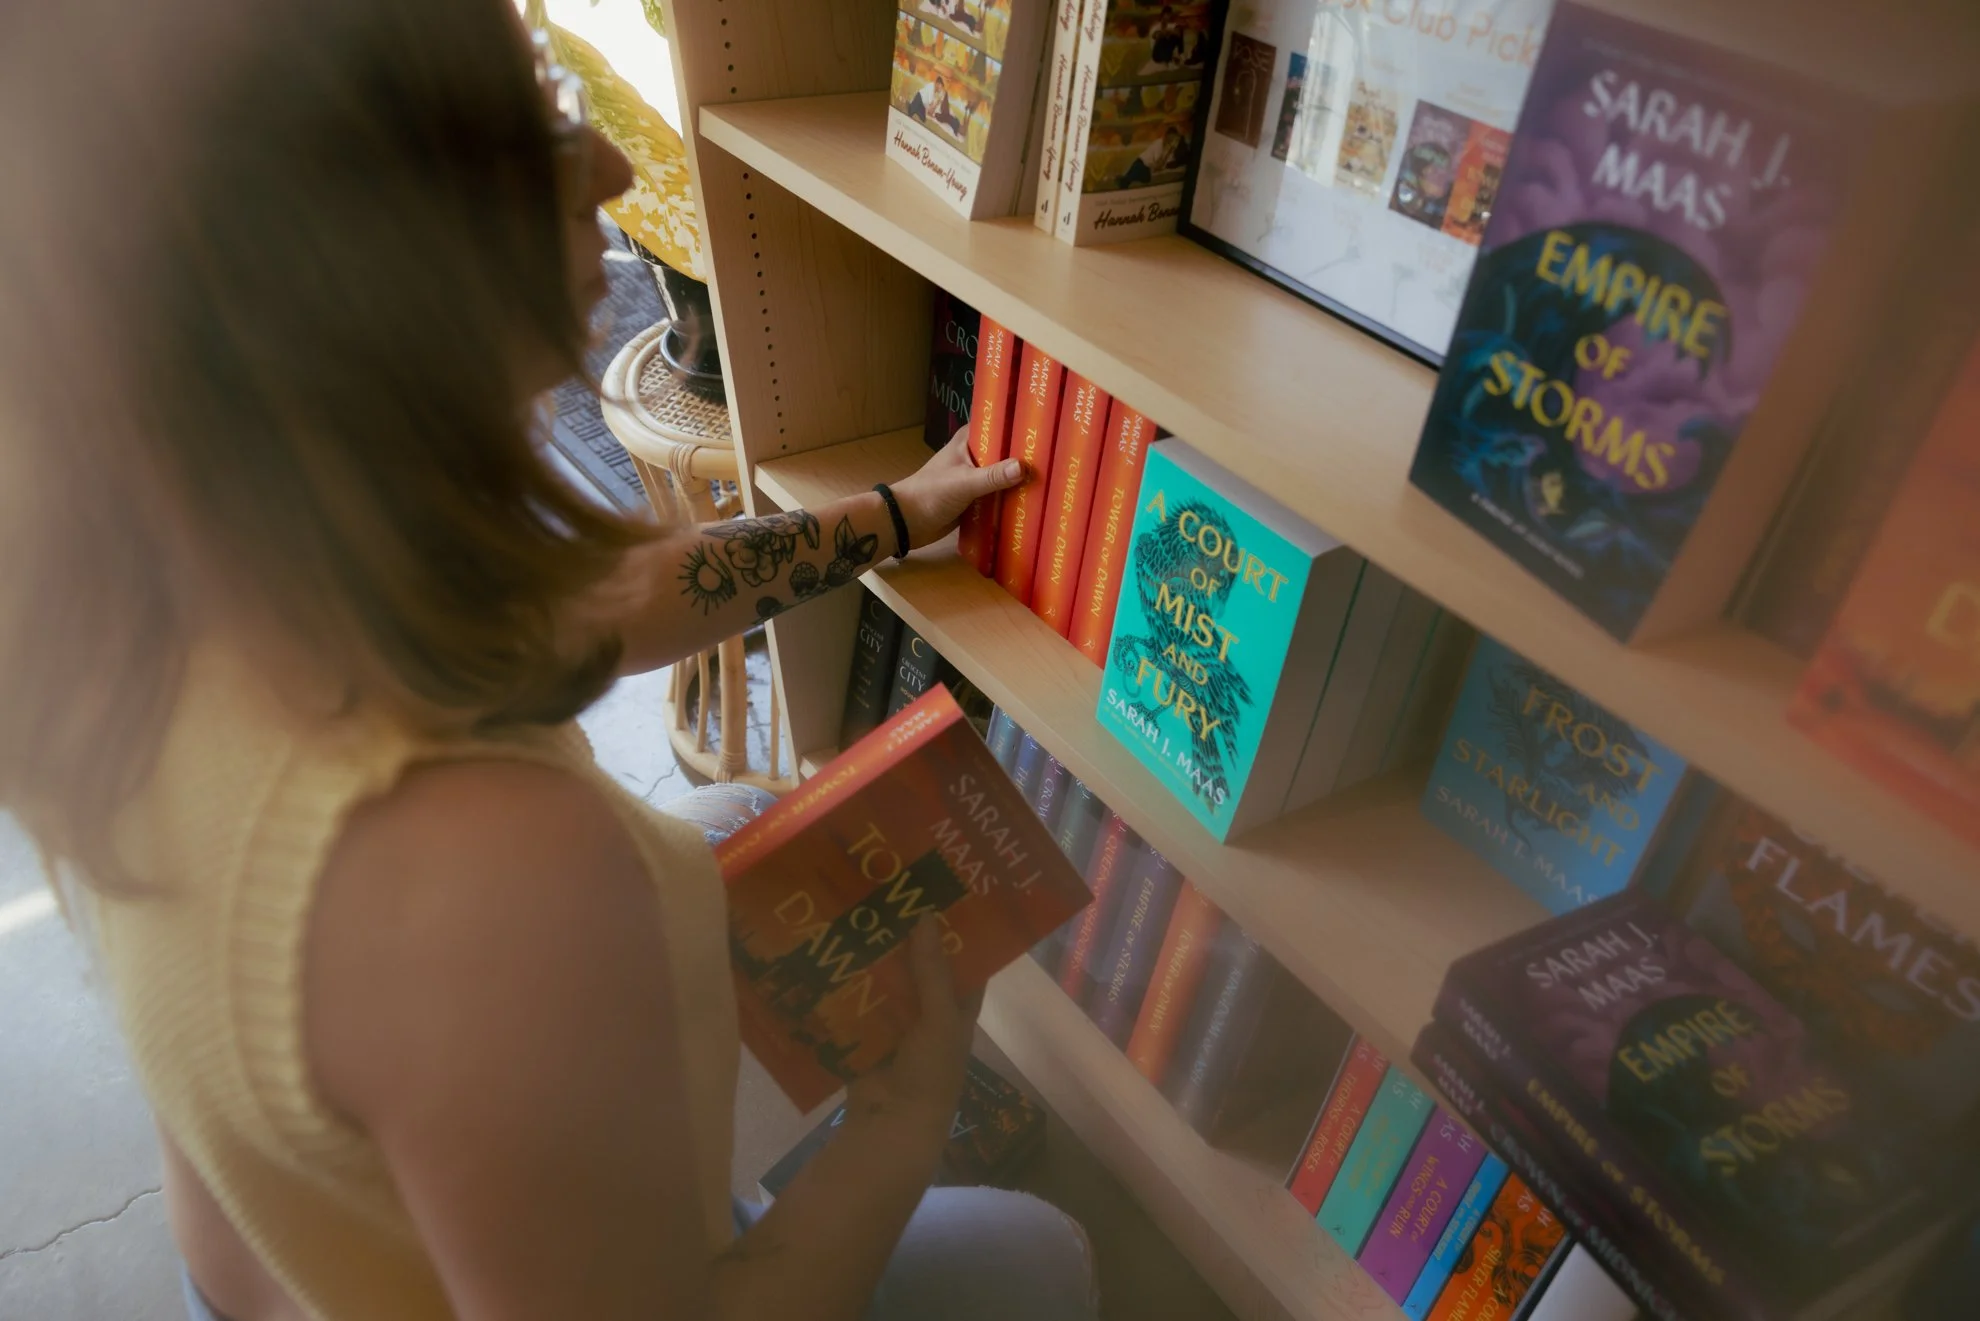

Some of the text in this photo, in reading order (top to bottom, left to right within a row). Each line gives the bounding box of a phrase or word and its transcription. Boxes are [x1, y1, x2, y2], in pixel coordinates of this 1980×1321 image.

[1055, 53, 1068, 101] Hannah
[1080, 64, 1093, 112] Hannah
[893, 130, 921, 160] Hannah
[1583, 70, 1753, 170] SARAH
[1751, 132, 1793, 188] J.
[1592, 142, 1731, 232] MAAS
[1093, 204, 1146, 231] Hannah
[1535, 230, 1728, 361] EMPIRE
[945, 320, 978, 359] CRO
[985, 331, 995, 367] MAAS
[993, 329, 1004, 368] SARAH
[1574, 334, 1632, 382] OF
[930, 374, 971, 425] MIDN
[1029, 360, 1040, 395] MAAS
[1038, 356, 1050, 398] SARAH
[979, 398, 993, 455] TOWER
[1073, 387, 1085, 423] MAAS
[1084, 384, 1097, 426] SARAH
[1481, 351, 1677, 492] STORMS
[1118, 416, 1131, 453] MAAS
[1129, 414, 1143, 457] SARAH
[1063, 456, 1081, 513] TOWER
[1011, 506, 1026, 556] DAWN
[1104, 487, 1125, 544] TOWER
[1050, 536, 1067, 585] DAWN
[1145, 489, 1289, 603] A COURT
[1090, 567, 1109, 617] DAWN
[1190, 567, 1221, 598] OF
[860, 628, 884, 653] CITY
[1154, 583, 1239, 664] MIST
[898, 664, 928, 692] CITY
[1162, 643, 1209, 687] AND
[1135, 657, 1221, 743] FURY
[1105, 687, 1161, 744] SARAH
[1160, 735, 1173, 758] J.
[1176, 751, 1226, 806] MAAS
[1521, 682, 1664, 794] FROST
[950, 772, 1030, 871] SARAH
[1037, 777, 1056, 822] CROW
[1435, 784, 1509, 846] SARAH
[1452, 736, 1626, 868] STARLIGHT
[1578, 780, 1641, 832] AND
[929, 816, 1000, 897] MAAS
[1096, 834, 1119, 881] QUEEN
[849, 905, 896, 946] OF
[1131, 877, 1155, 931] EMPIRE
[1744, 835, 1980, 1022] FLAMES
[774, 889, 890, 1019] DAWN
[1108, 947, 1132, 1005] STORMS
[1167, 928, 1195, 979] TOWER
[1525, 927, 1635, 990] SARAH
[1626, 920, 1661, 950] J.
[1576, 953, 1668, 1013] MAAS
[1616, 1000, 1755, 1085] EMPIRE
[1328, 1071, 1358, 1123] THORNS
[1332, 1115, 1357, 1161] COURT
[1701, 1075, 1850, 1178] STORMS
[1305, 1132, 1331, 1174] ROSES
[1410, 1153, 1441, 1196] WINGS
[1434, 1174, 1449, 1191] A
[1388, 1206, 1412, 1241] RUIN
[1417, 1190, 1443, 1237] COURT
[1445, 1244, 1503, 1321] SILVER FLAME
